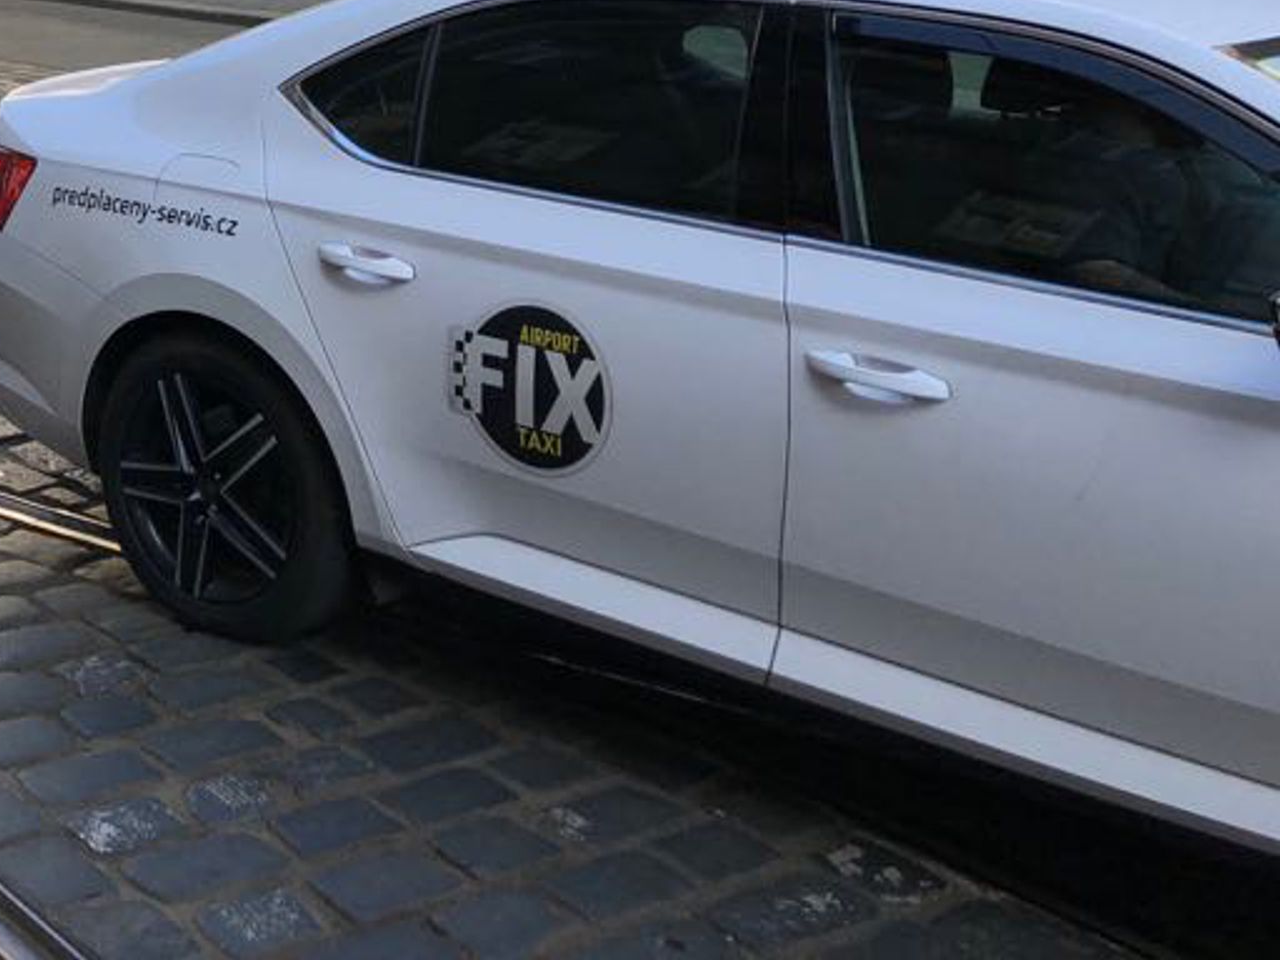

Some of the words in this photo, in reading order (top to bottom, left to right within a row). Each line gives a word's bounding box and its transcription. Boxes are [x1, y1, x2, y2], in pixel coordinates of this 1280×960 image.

[52, 186, 239, 236] predplaceny-servis.cz
[519, 324, 580, 354] AIRPORT
[465, 334, 601, 445] FIX
[520, 427, 562, 457] TAXI
